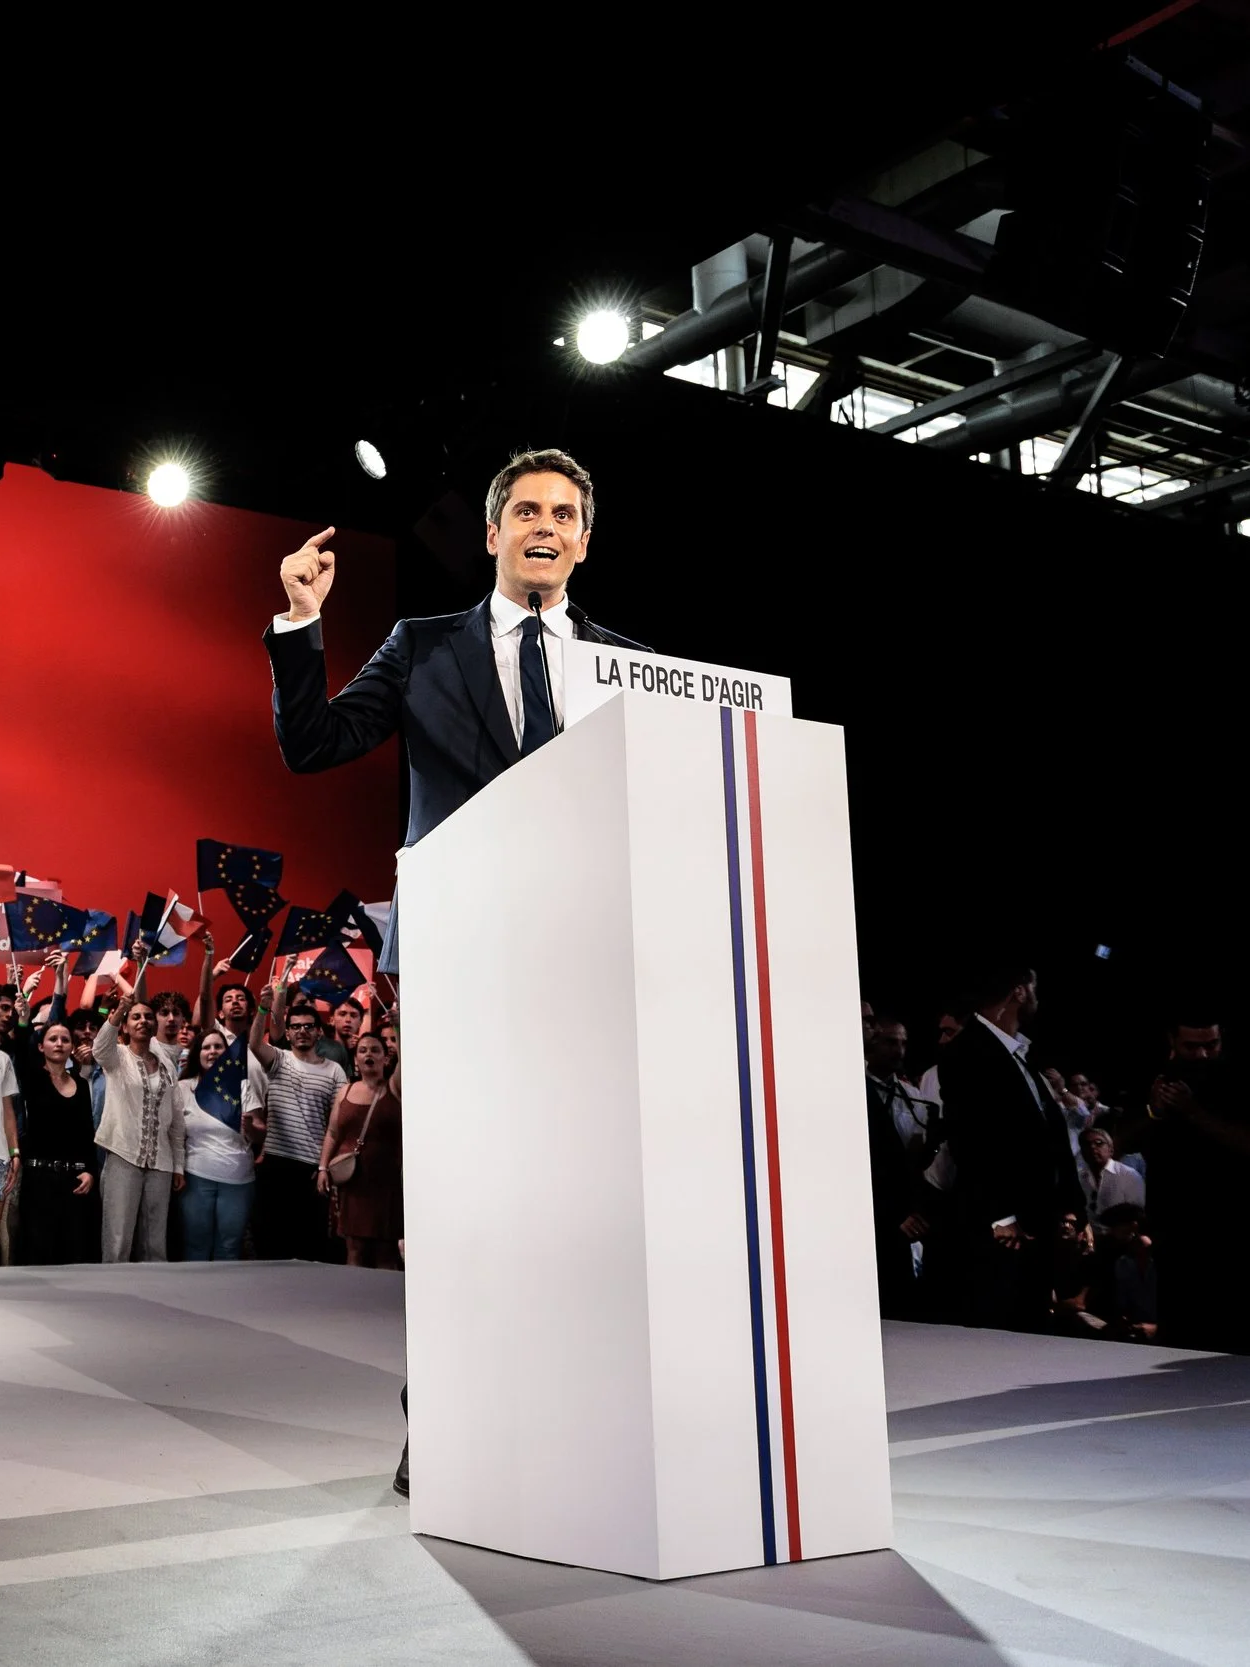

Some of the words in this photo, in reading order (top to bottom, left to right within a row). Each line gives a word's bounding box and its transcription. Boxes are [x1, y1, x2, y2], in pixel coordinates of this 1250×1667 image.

[595, 655, 623, 687] LA
[629, 661, 695, 699] FORCE
[701, 673, 763, 711] D'AGIR
